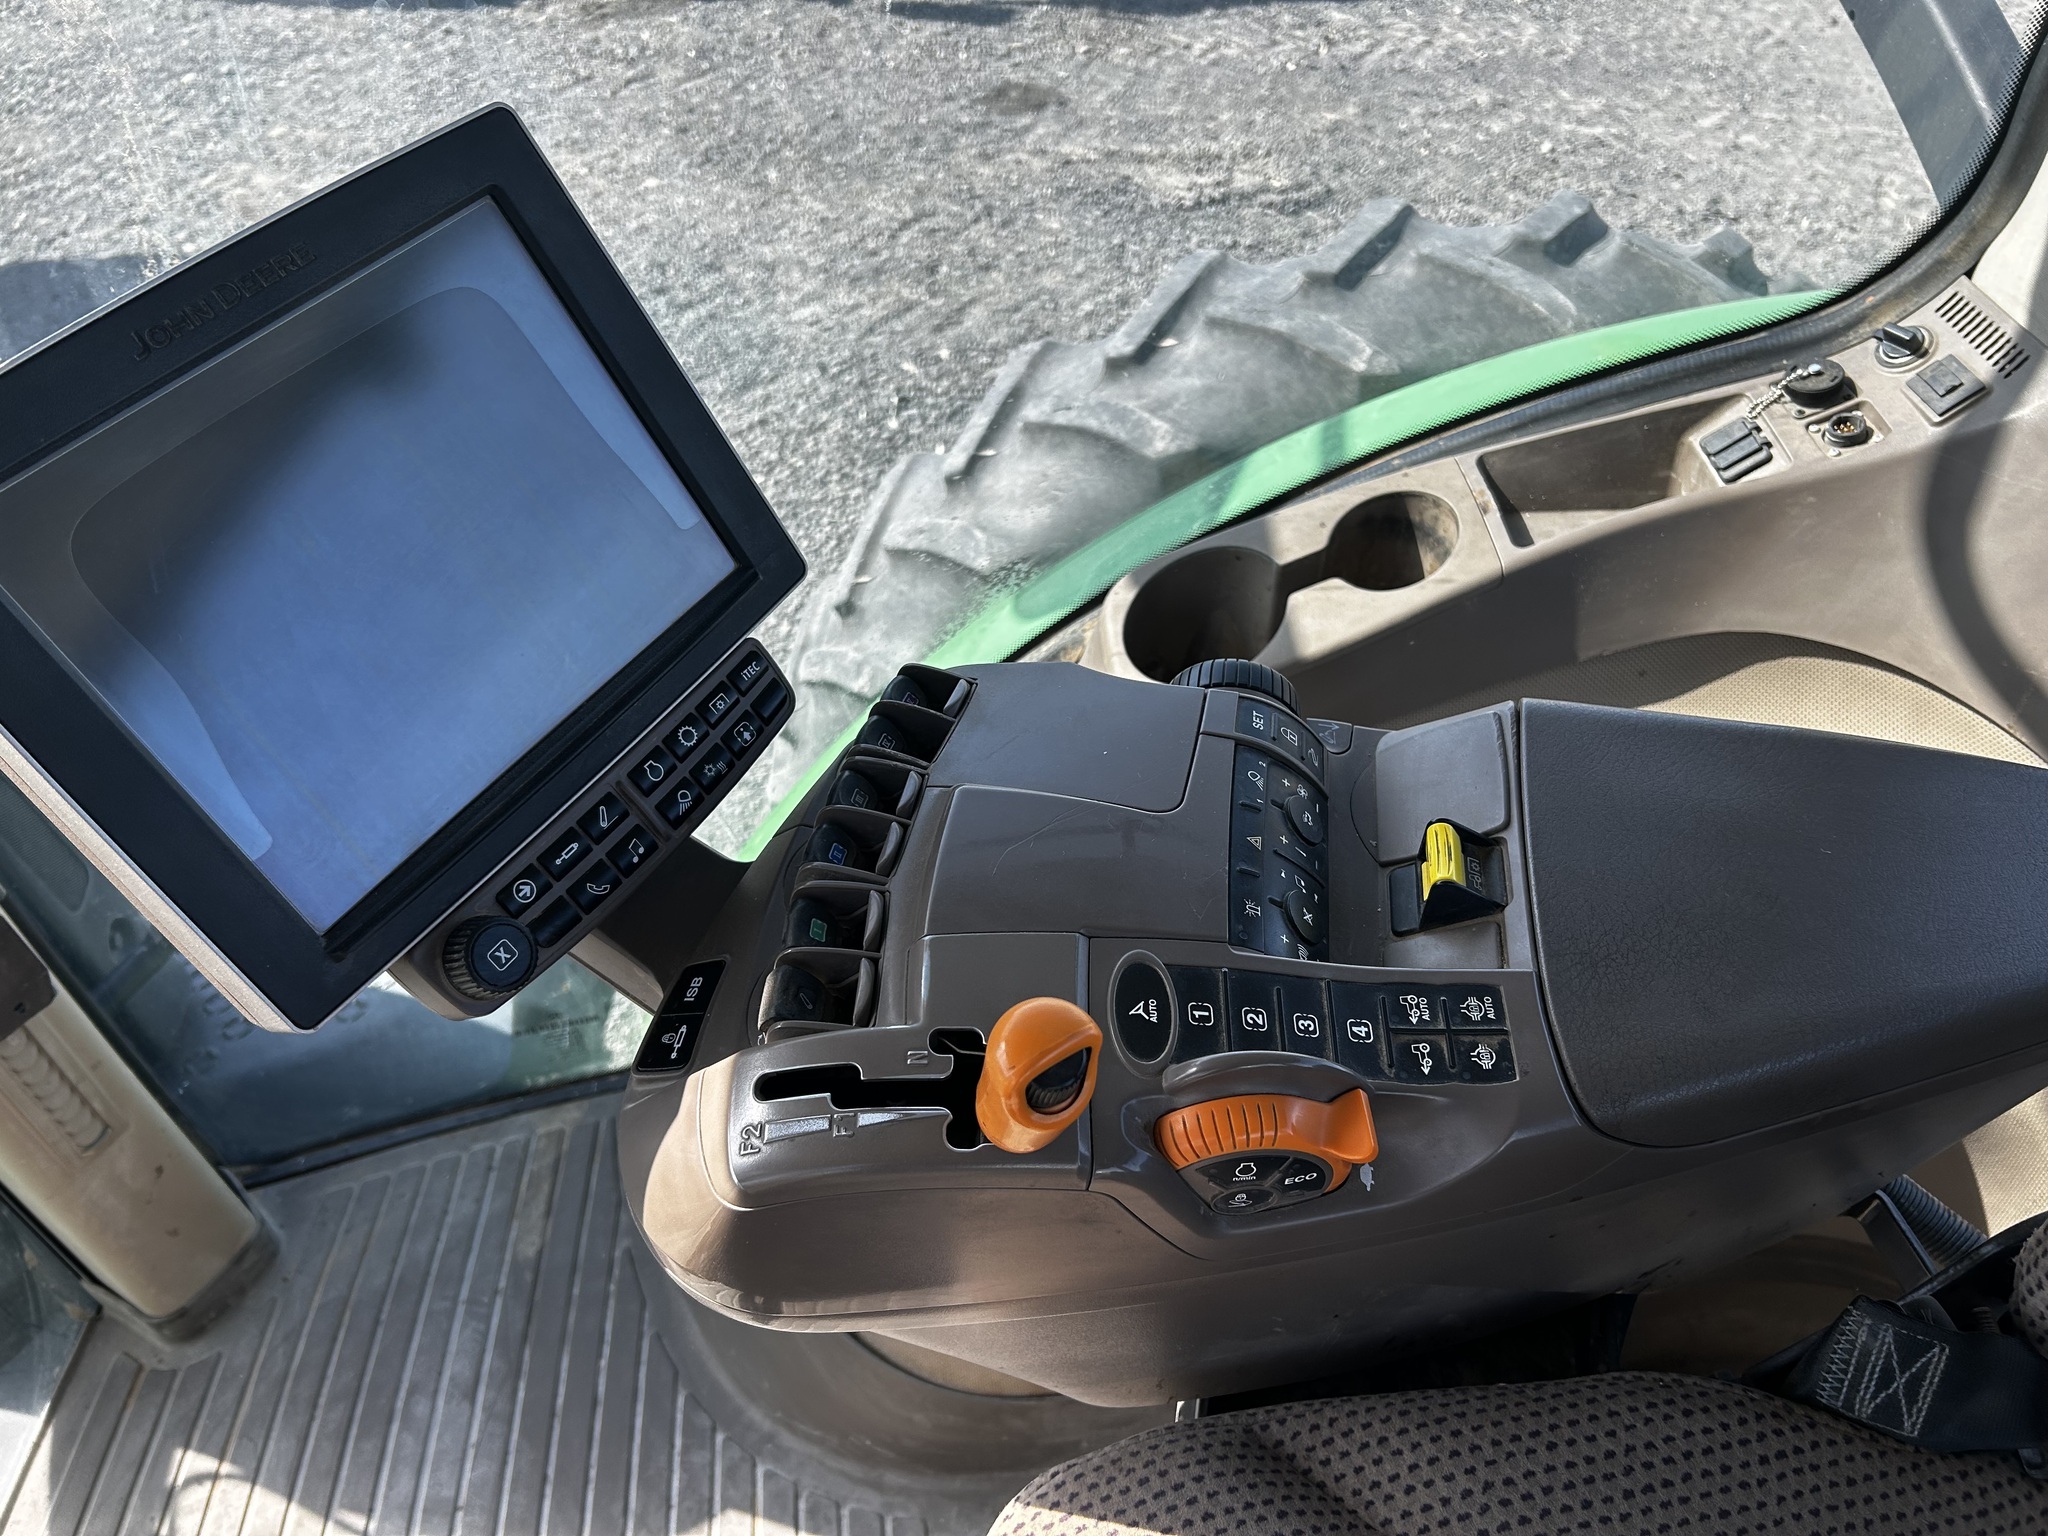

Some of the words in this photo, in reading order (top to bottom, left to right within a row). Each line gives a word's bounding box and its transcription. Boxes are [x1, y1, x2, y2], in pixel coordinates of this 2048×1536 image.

[130, 298, 215, 361] JOHN
[210, 243, 316, 311] DEERE
[740, 661, 760, 681] iTEC
[1252, 710, 1264, 730] SET
[855, 794, 864, 804] III
[683, 976, 703, 1002] ISB
[1148, 999, 1158, 1023] AUTO
[1192, 1010, 1210, 1019] 1
[1418, 997, 1431, 1021] AUTO
[1483, 996, 1496, 1020] AUTO
[1246, 1014, 1263, 1026] 2
[1298, 1019, 1315, 1031] 3
[1351, 1025, 1369, 1037] 4
[907, 1050, 928, 1065] N
[739, 1122, 763, 1157] F2
[1284, 1172, 1318, 1185] ECO
